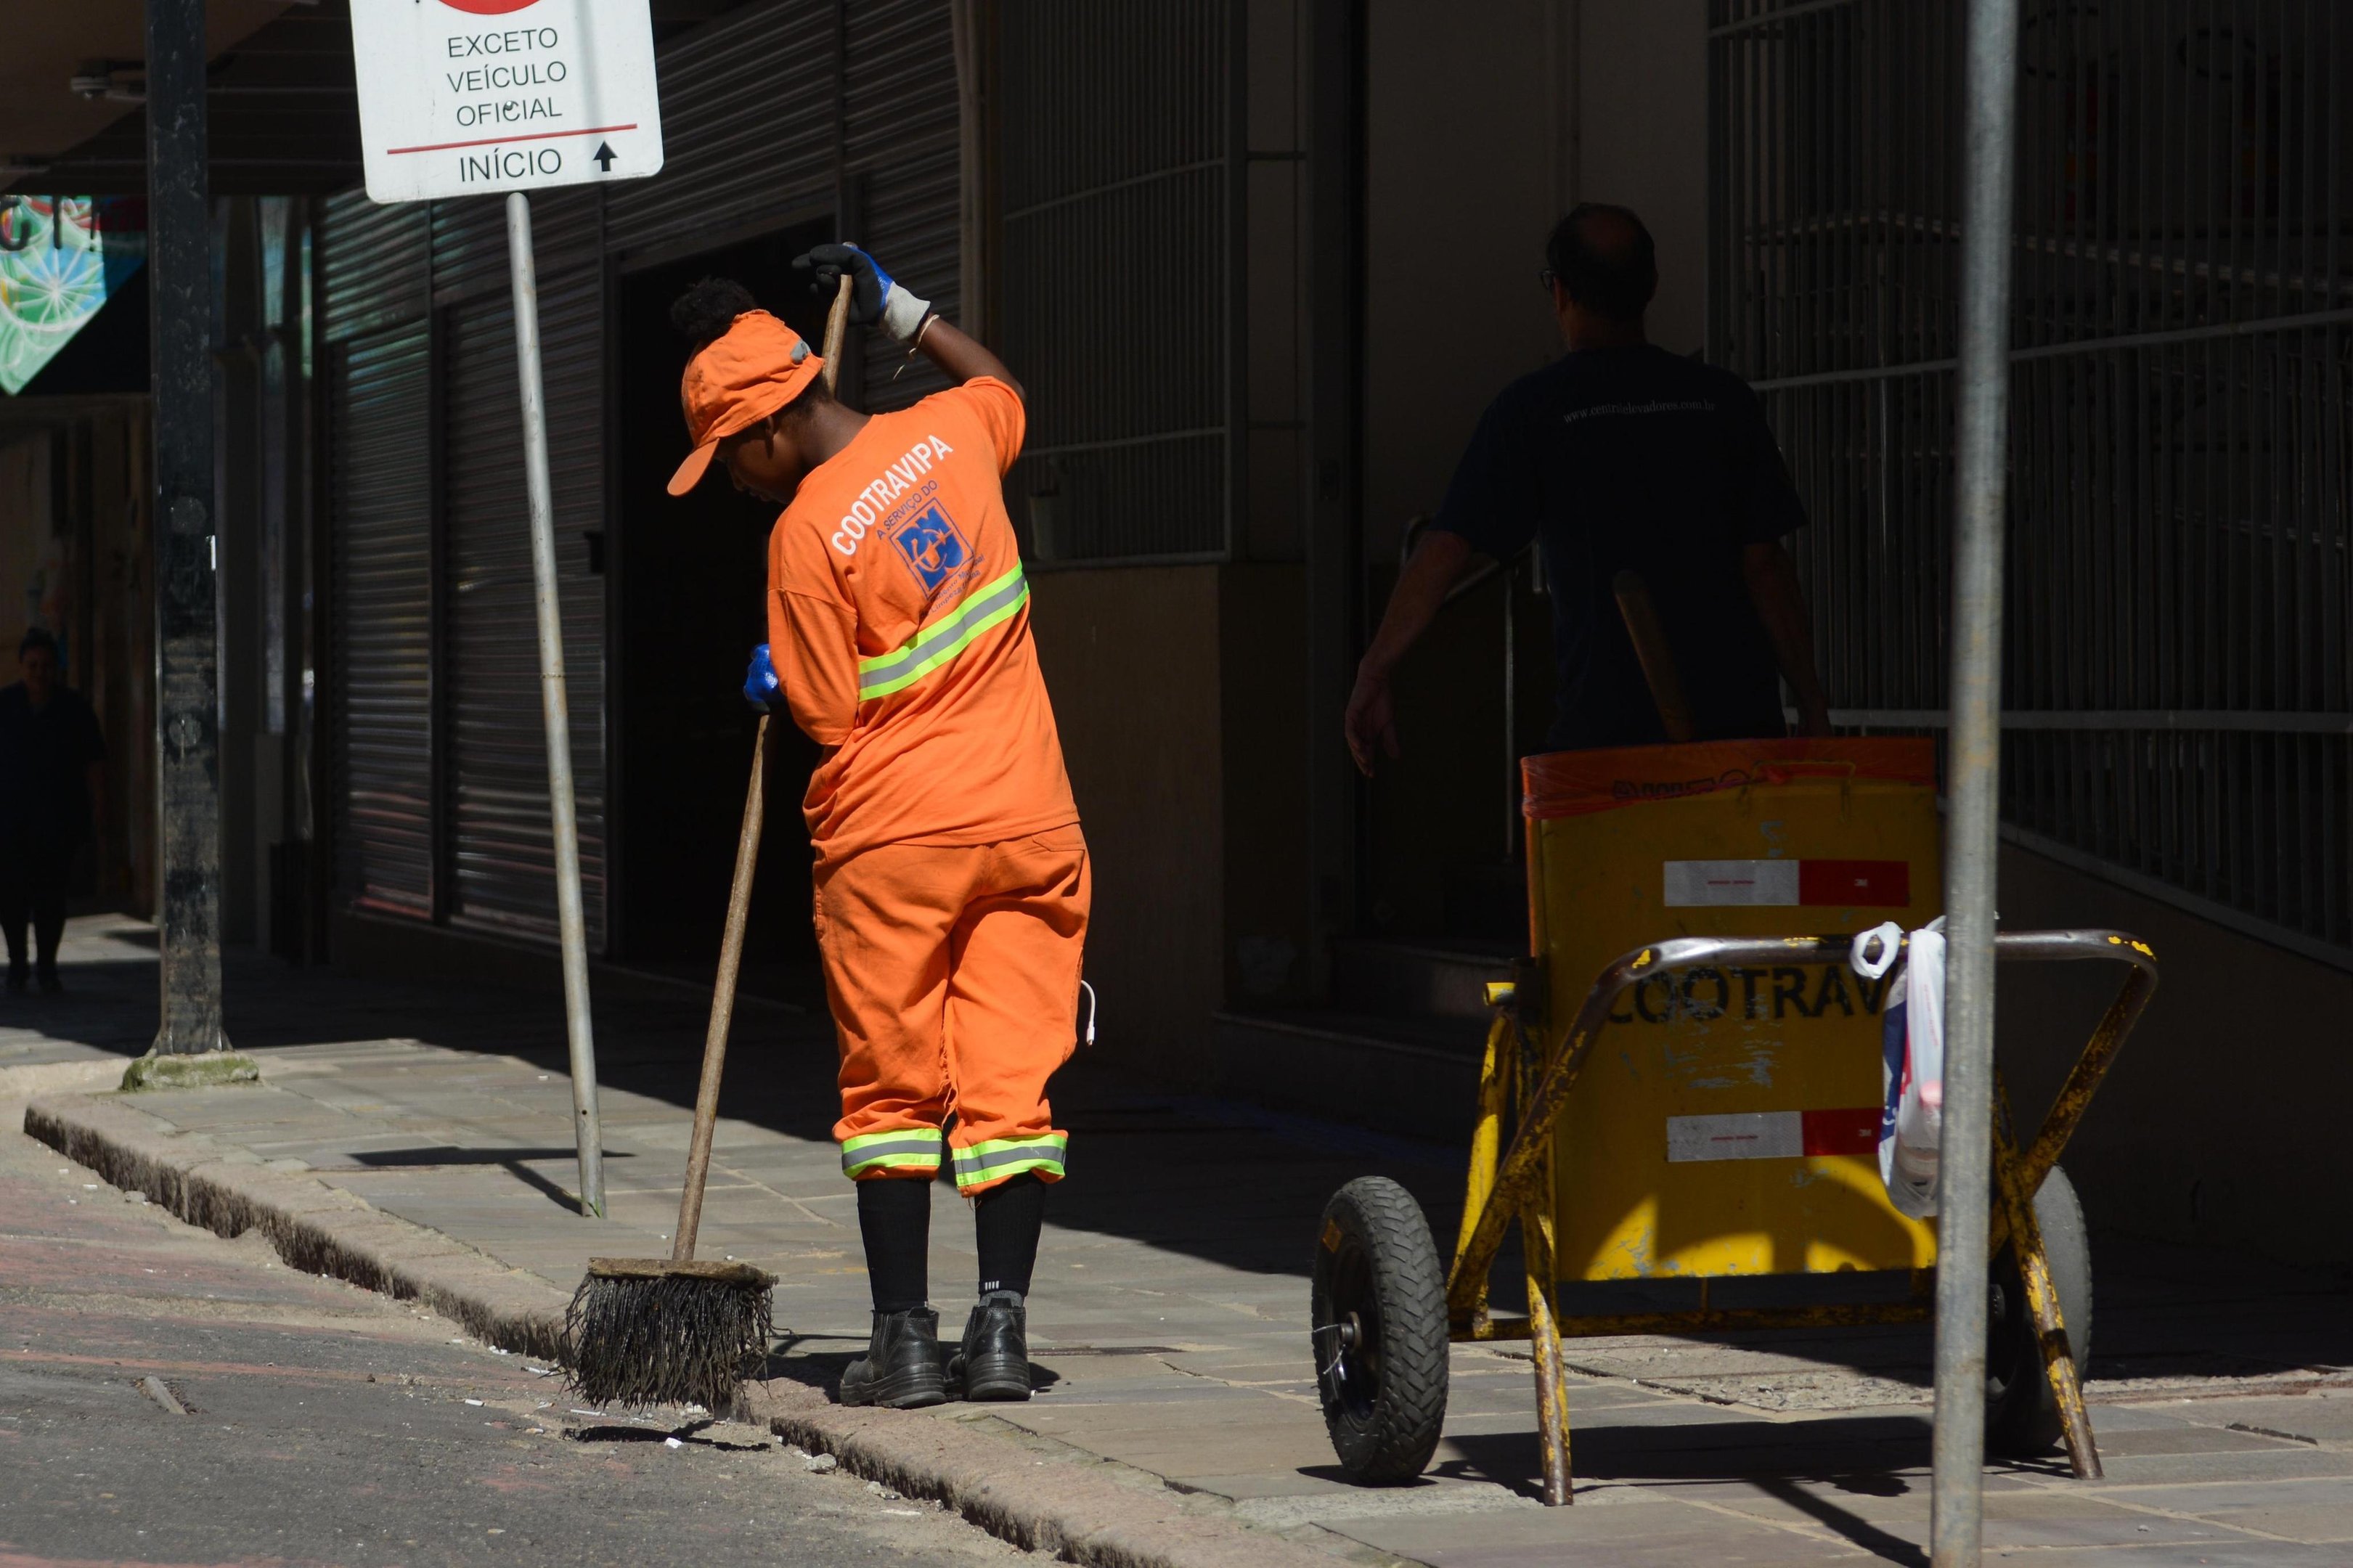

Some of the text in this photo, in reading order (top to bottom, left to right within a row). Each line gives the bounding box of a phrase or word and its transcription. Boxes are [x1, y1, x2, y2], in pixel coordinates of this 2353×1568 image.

[447, 27, 558, 58] EXCETO
[446, 60, 566, 93] VEÍCULO
[456, 97, 563, 126] OFICIAL
[459, 147, 562, 182] INÍCIO
[831, 435, 953, 556] COOTRAVIPA
[876, 480, 937, 540] A SERVIÇO DO
